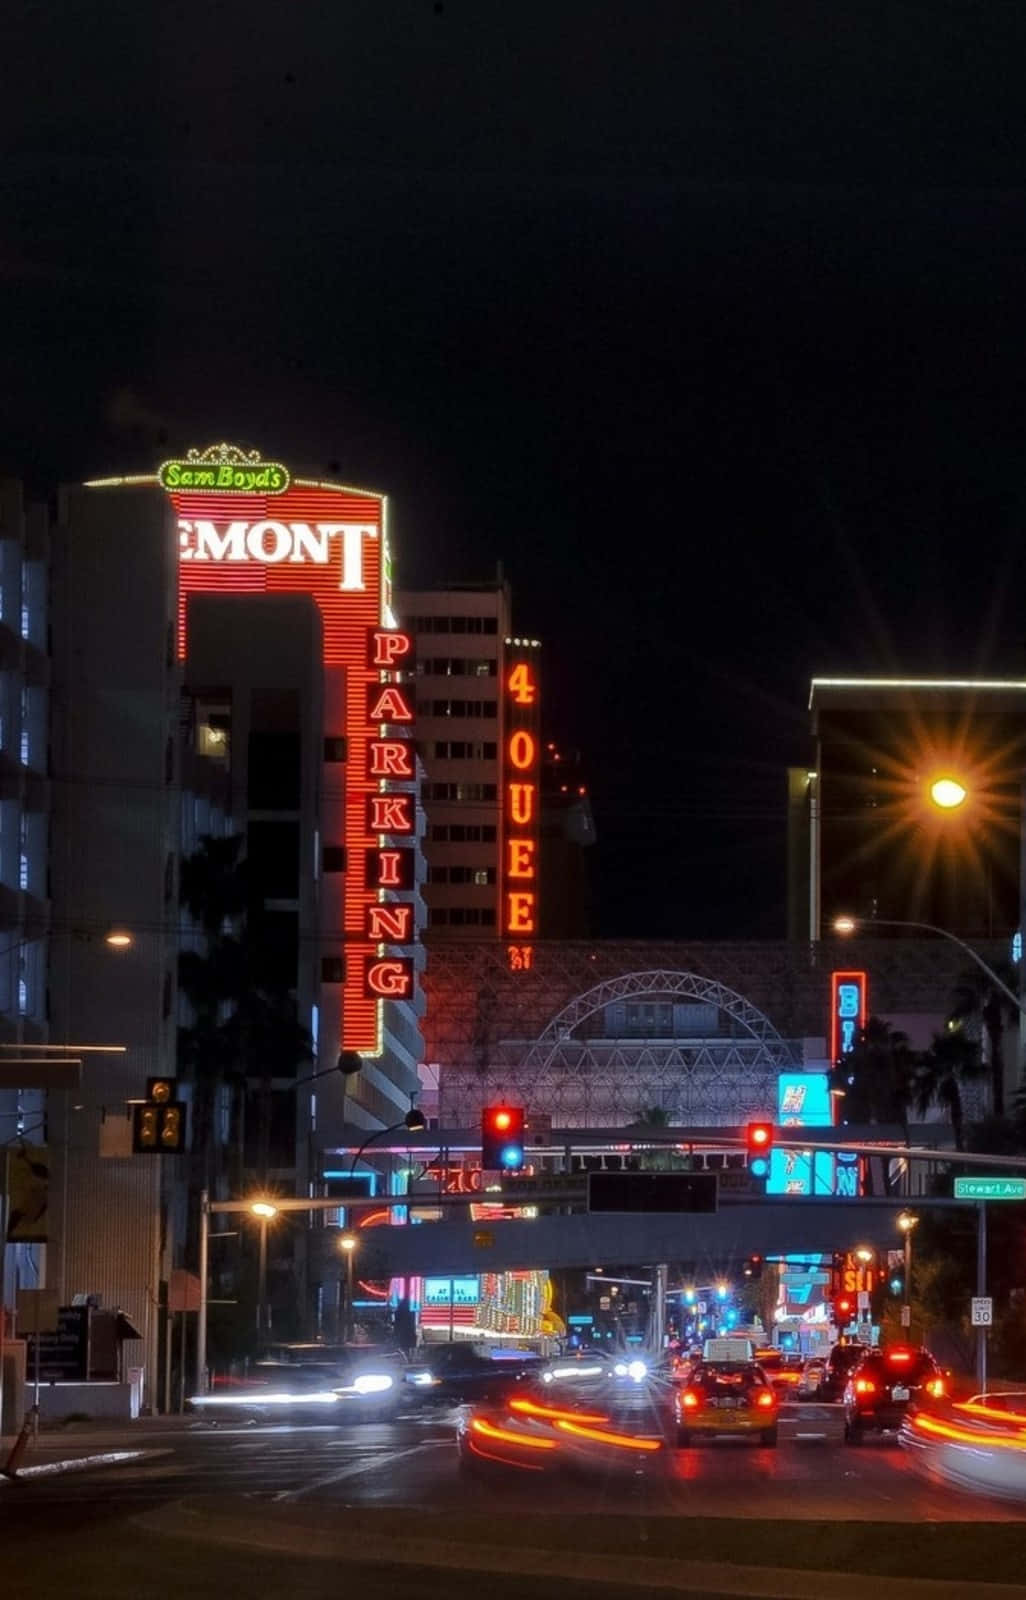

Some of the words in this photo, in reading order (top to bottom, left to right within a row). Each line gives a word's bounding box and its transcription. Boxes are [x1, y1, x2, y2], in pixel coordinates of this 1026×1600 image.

[166, 464, 215, 487] Sam
[216, 466, 281, 490] Boyd's
[508, 664, 534, 703] 4
[368, 633, 413, 995] PARKING
[959, 1183, 1000, 1194] Stewart
[1004, 1183, 1025, 1194] Ave
[975, 1311, 990, 1322] 30
